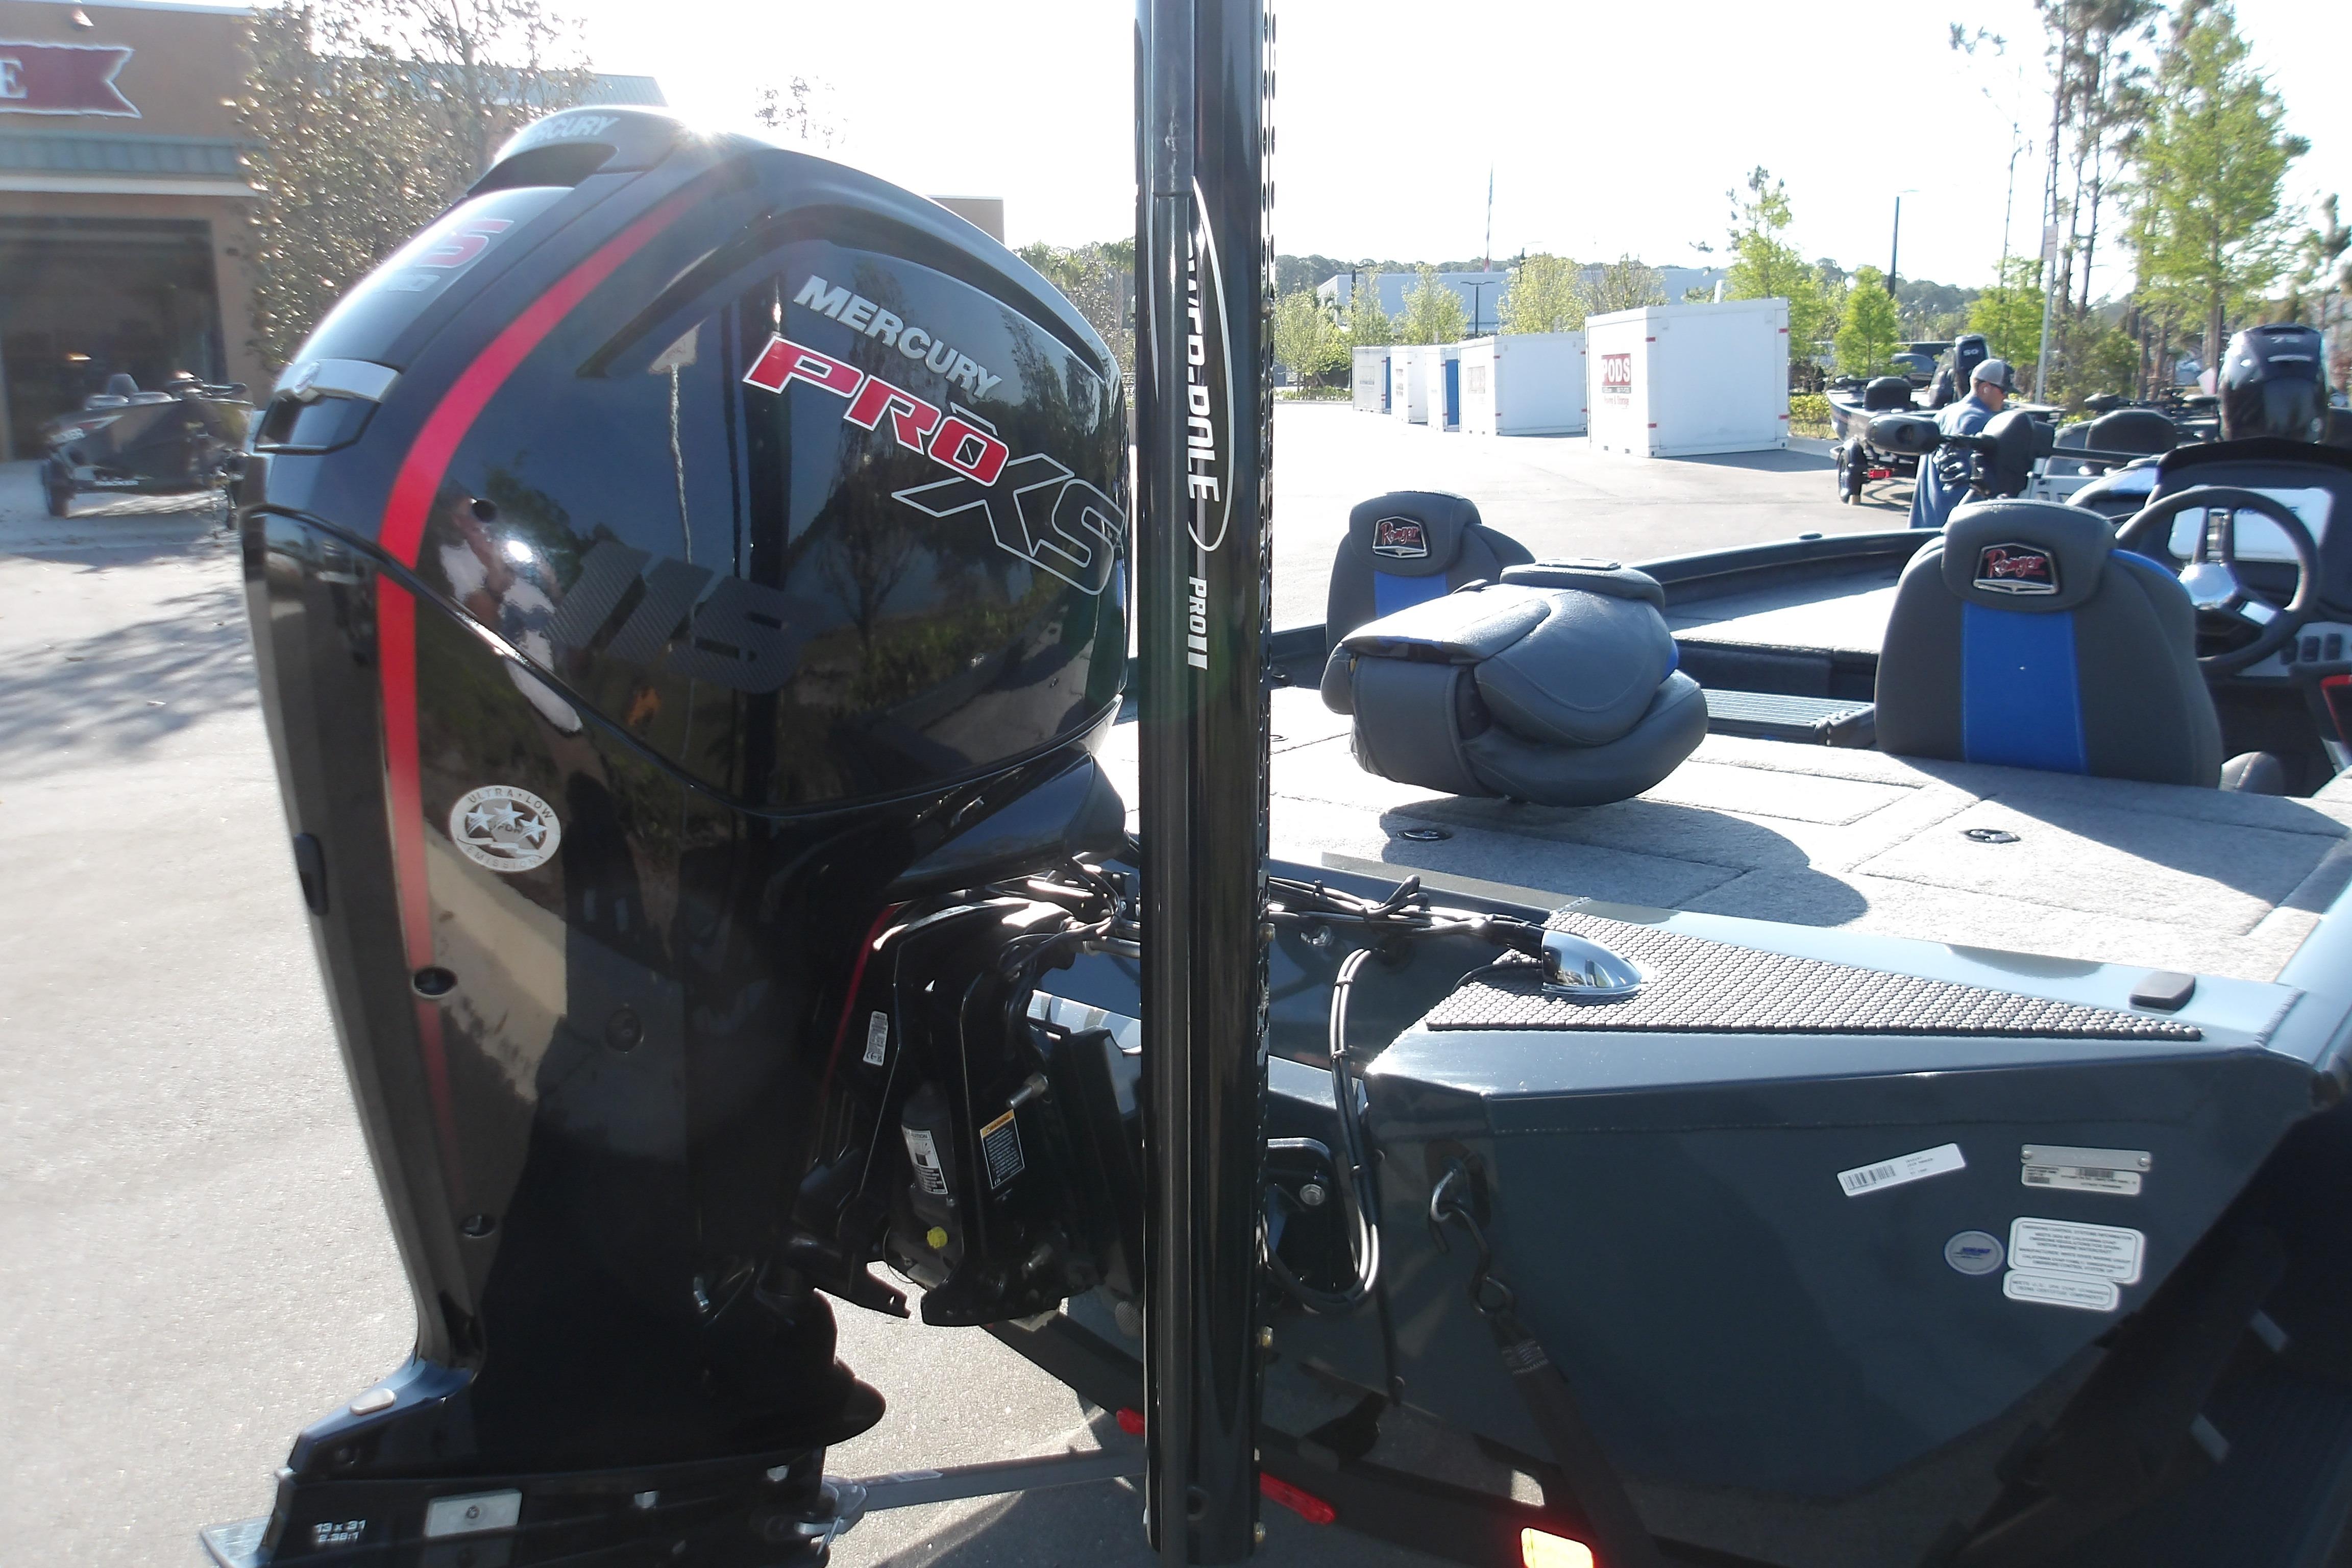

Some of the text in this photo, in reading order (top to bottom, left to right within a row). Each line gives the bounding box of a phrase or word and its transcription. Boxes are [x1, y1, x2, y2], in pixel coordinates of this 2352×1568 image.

[528, 114, 621, 142] RCURY
[793, 274, 1003, 400] MERCURY
[1602, 358, 1631, 383] PODS
[743, 335, 1125, 596] PRO XS
[468, 788, 553, 819] ULTRA LOW
[465, 845, 538, 869] EMISSION
[315, 1523, 332, 1532] 13
[348, 1520, 366, 1530] 31
